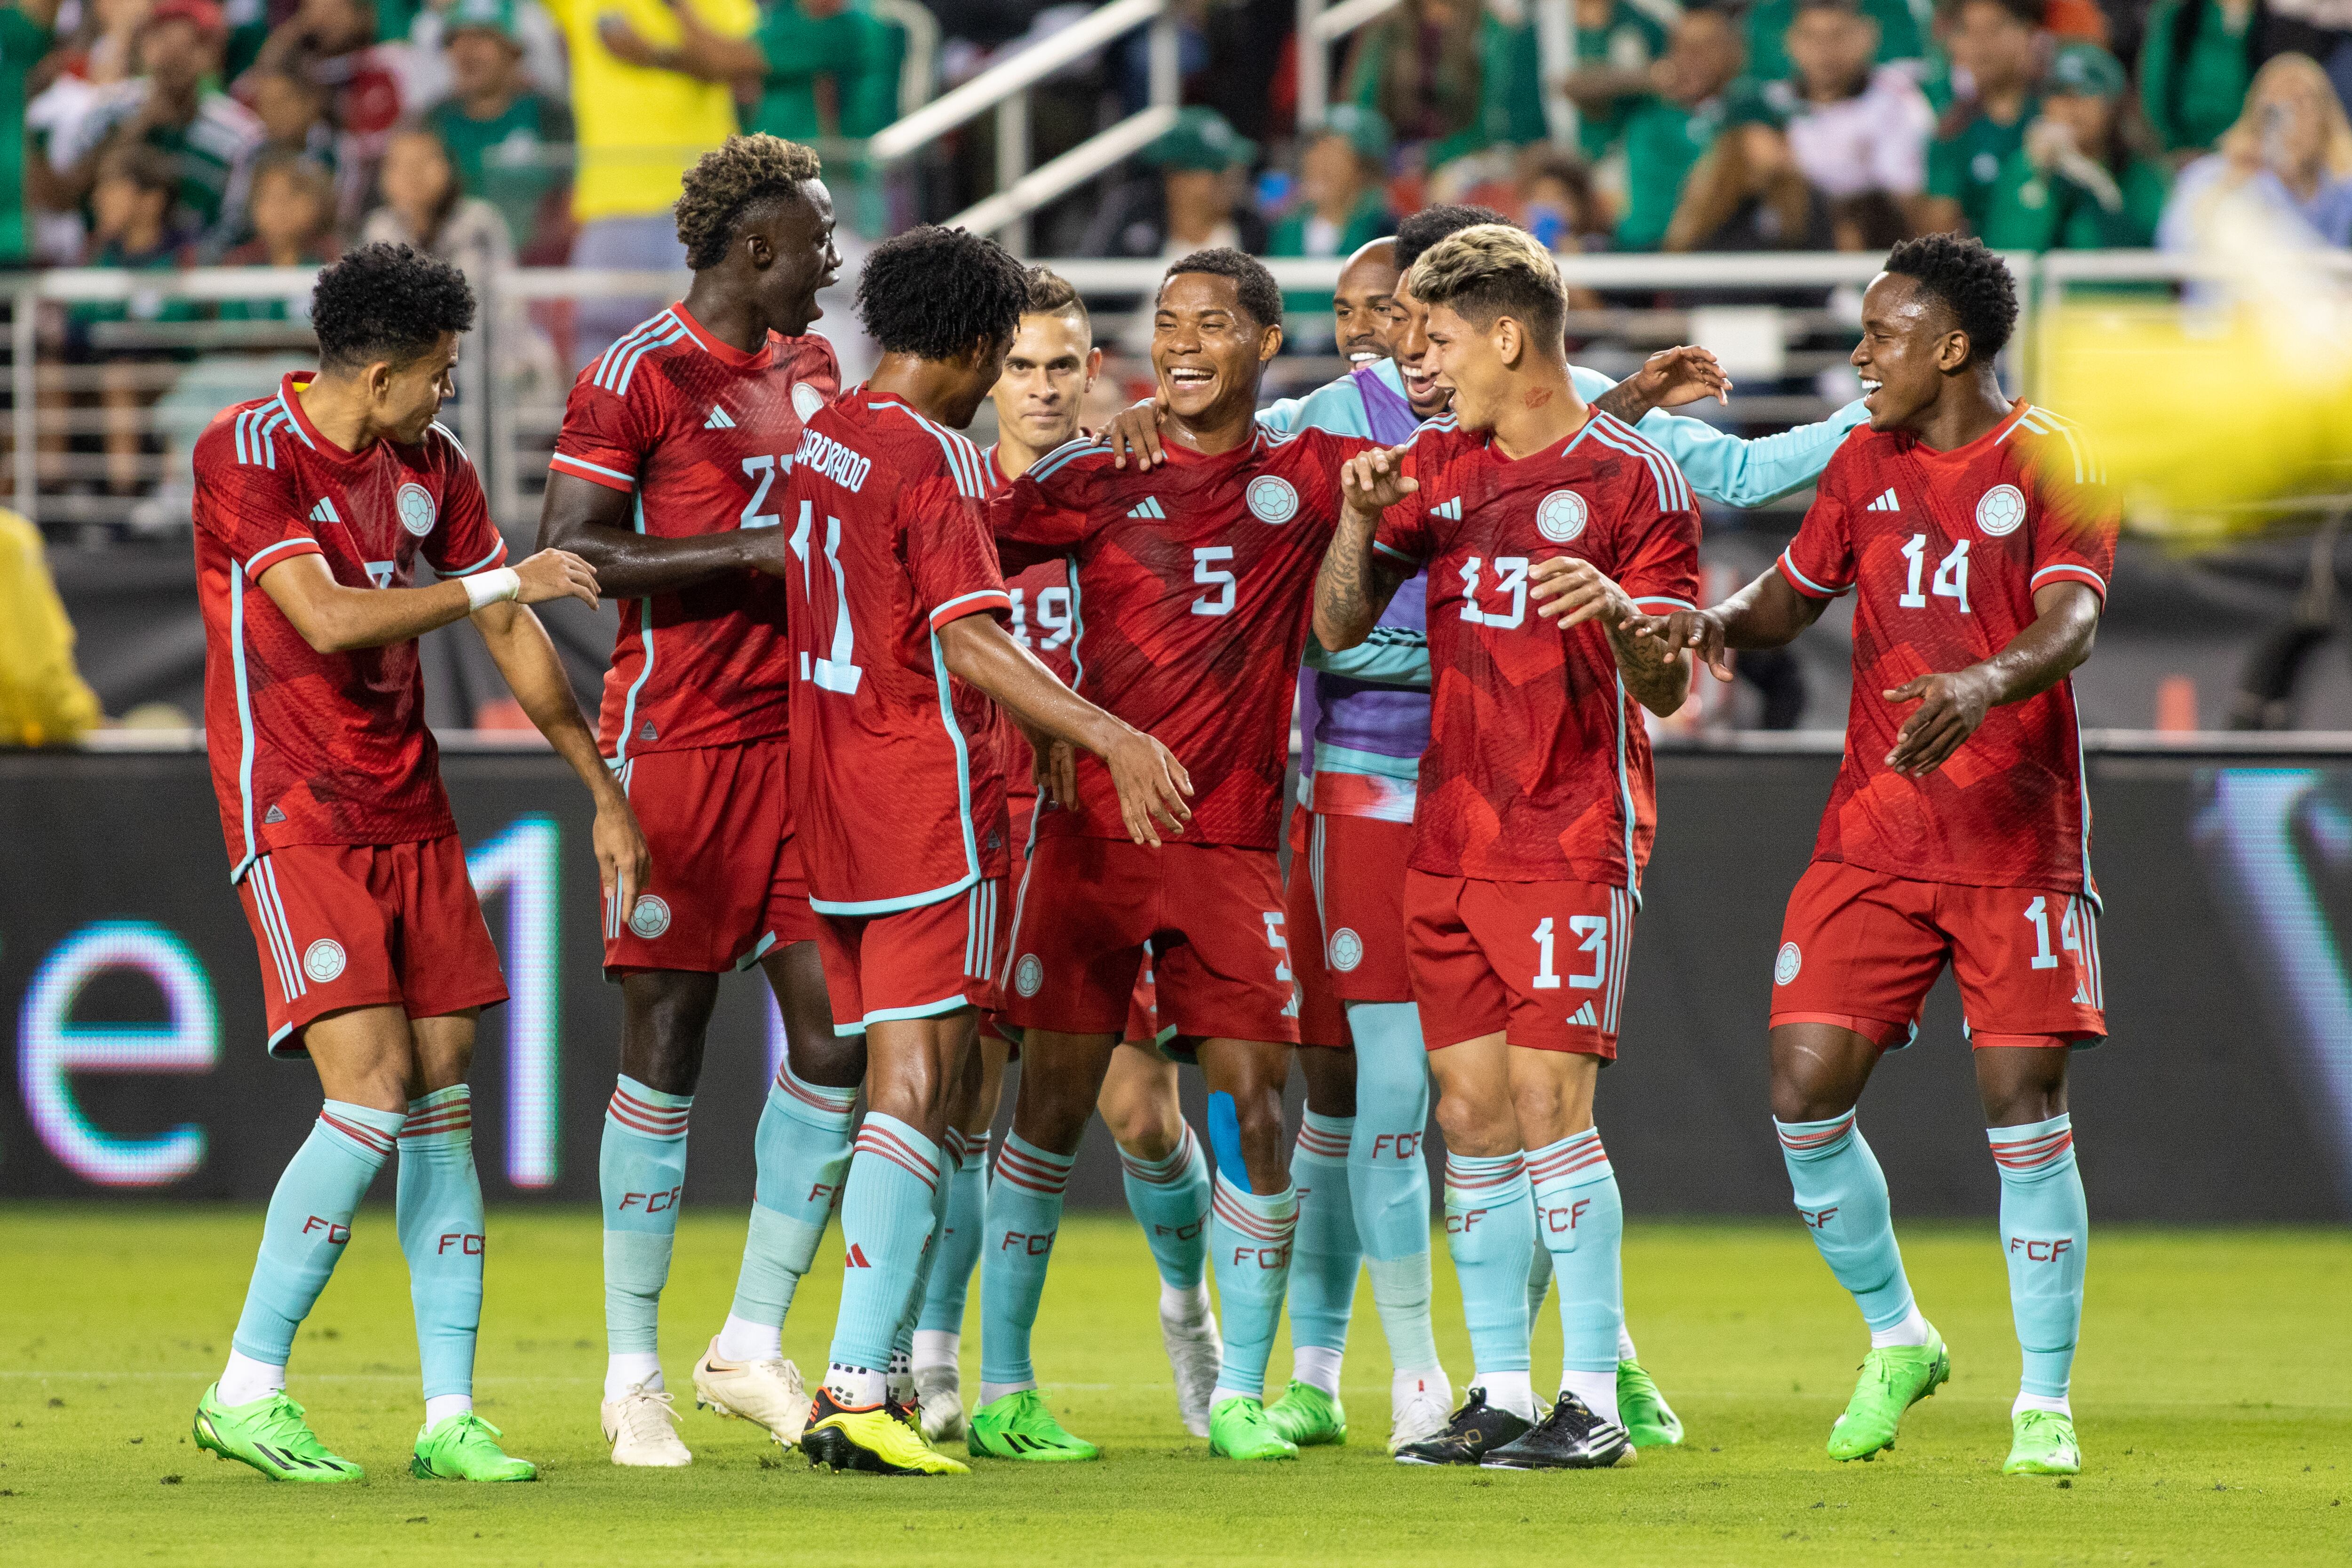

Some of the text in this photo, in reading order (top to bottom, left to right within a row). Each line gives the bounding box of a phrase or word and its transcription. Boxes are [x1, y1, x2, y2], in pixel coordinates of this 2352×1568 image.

[741, 454, 793, 529] 2
[1191, 546, 1236, 615] 5
[1459, 557, 1528, 629] 13
[1899, 533, 1971, 612] 14
[1009, 587, 1072, 650] 19
[1532, 915, 1607, 988] 13
[2024, 895, 2084, 970] 14
[1372, 1131, 1421, 1159] FCF
[302, 1215, 351, 1244] FC
[619, 1185, 681, 1213] FCF
[1445, 1210, 1487, 1234] CF
[1799, 1207, 1838, 1228] CF
[2011, 1237, 2072, 1262] FCF
